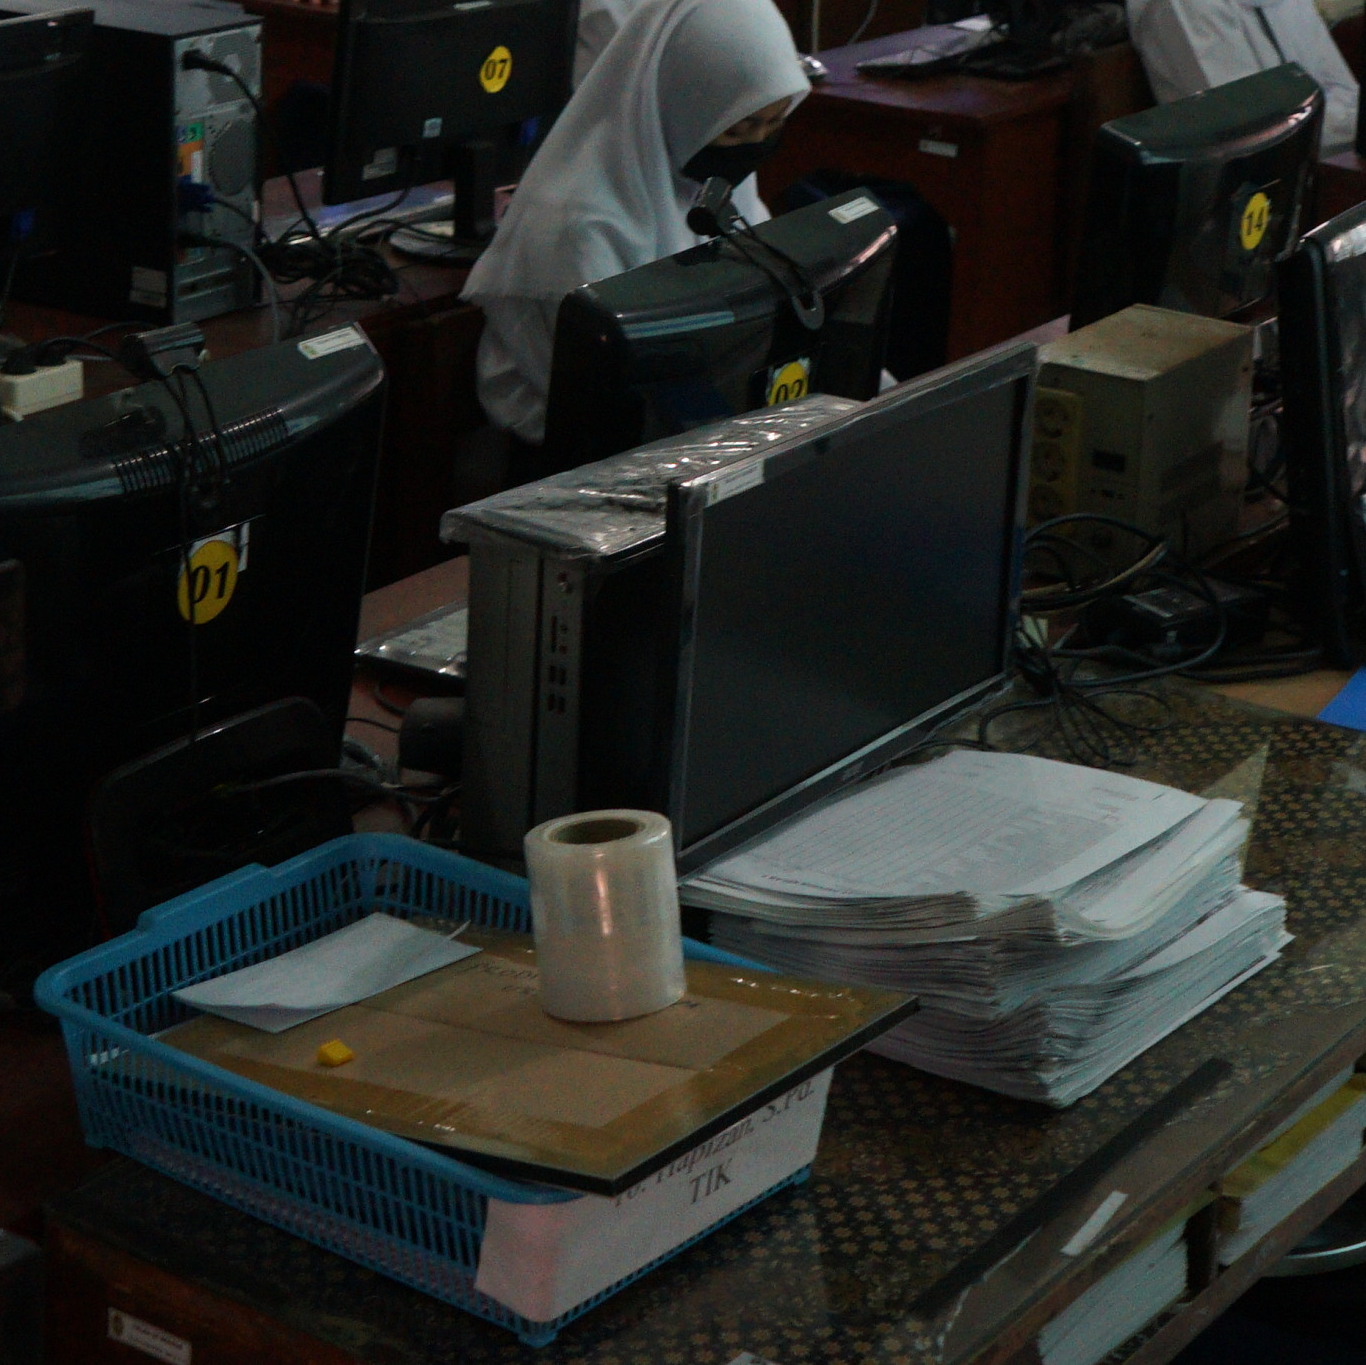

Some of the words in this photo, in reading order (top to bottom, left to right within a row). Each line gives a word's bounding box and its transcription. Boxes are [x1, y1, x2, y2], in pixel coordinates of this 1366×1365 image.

[485, 58, 507, 80] 07
[1246, 206, 1265, 236] 14
[191, 561, 230, 604] 01
[690, 1158, 733, 1205] TIK
